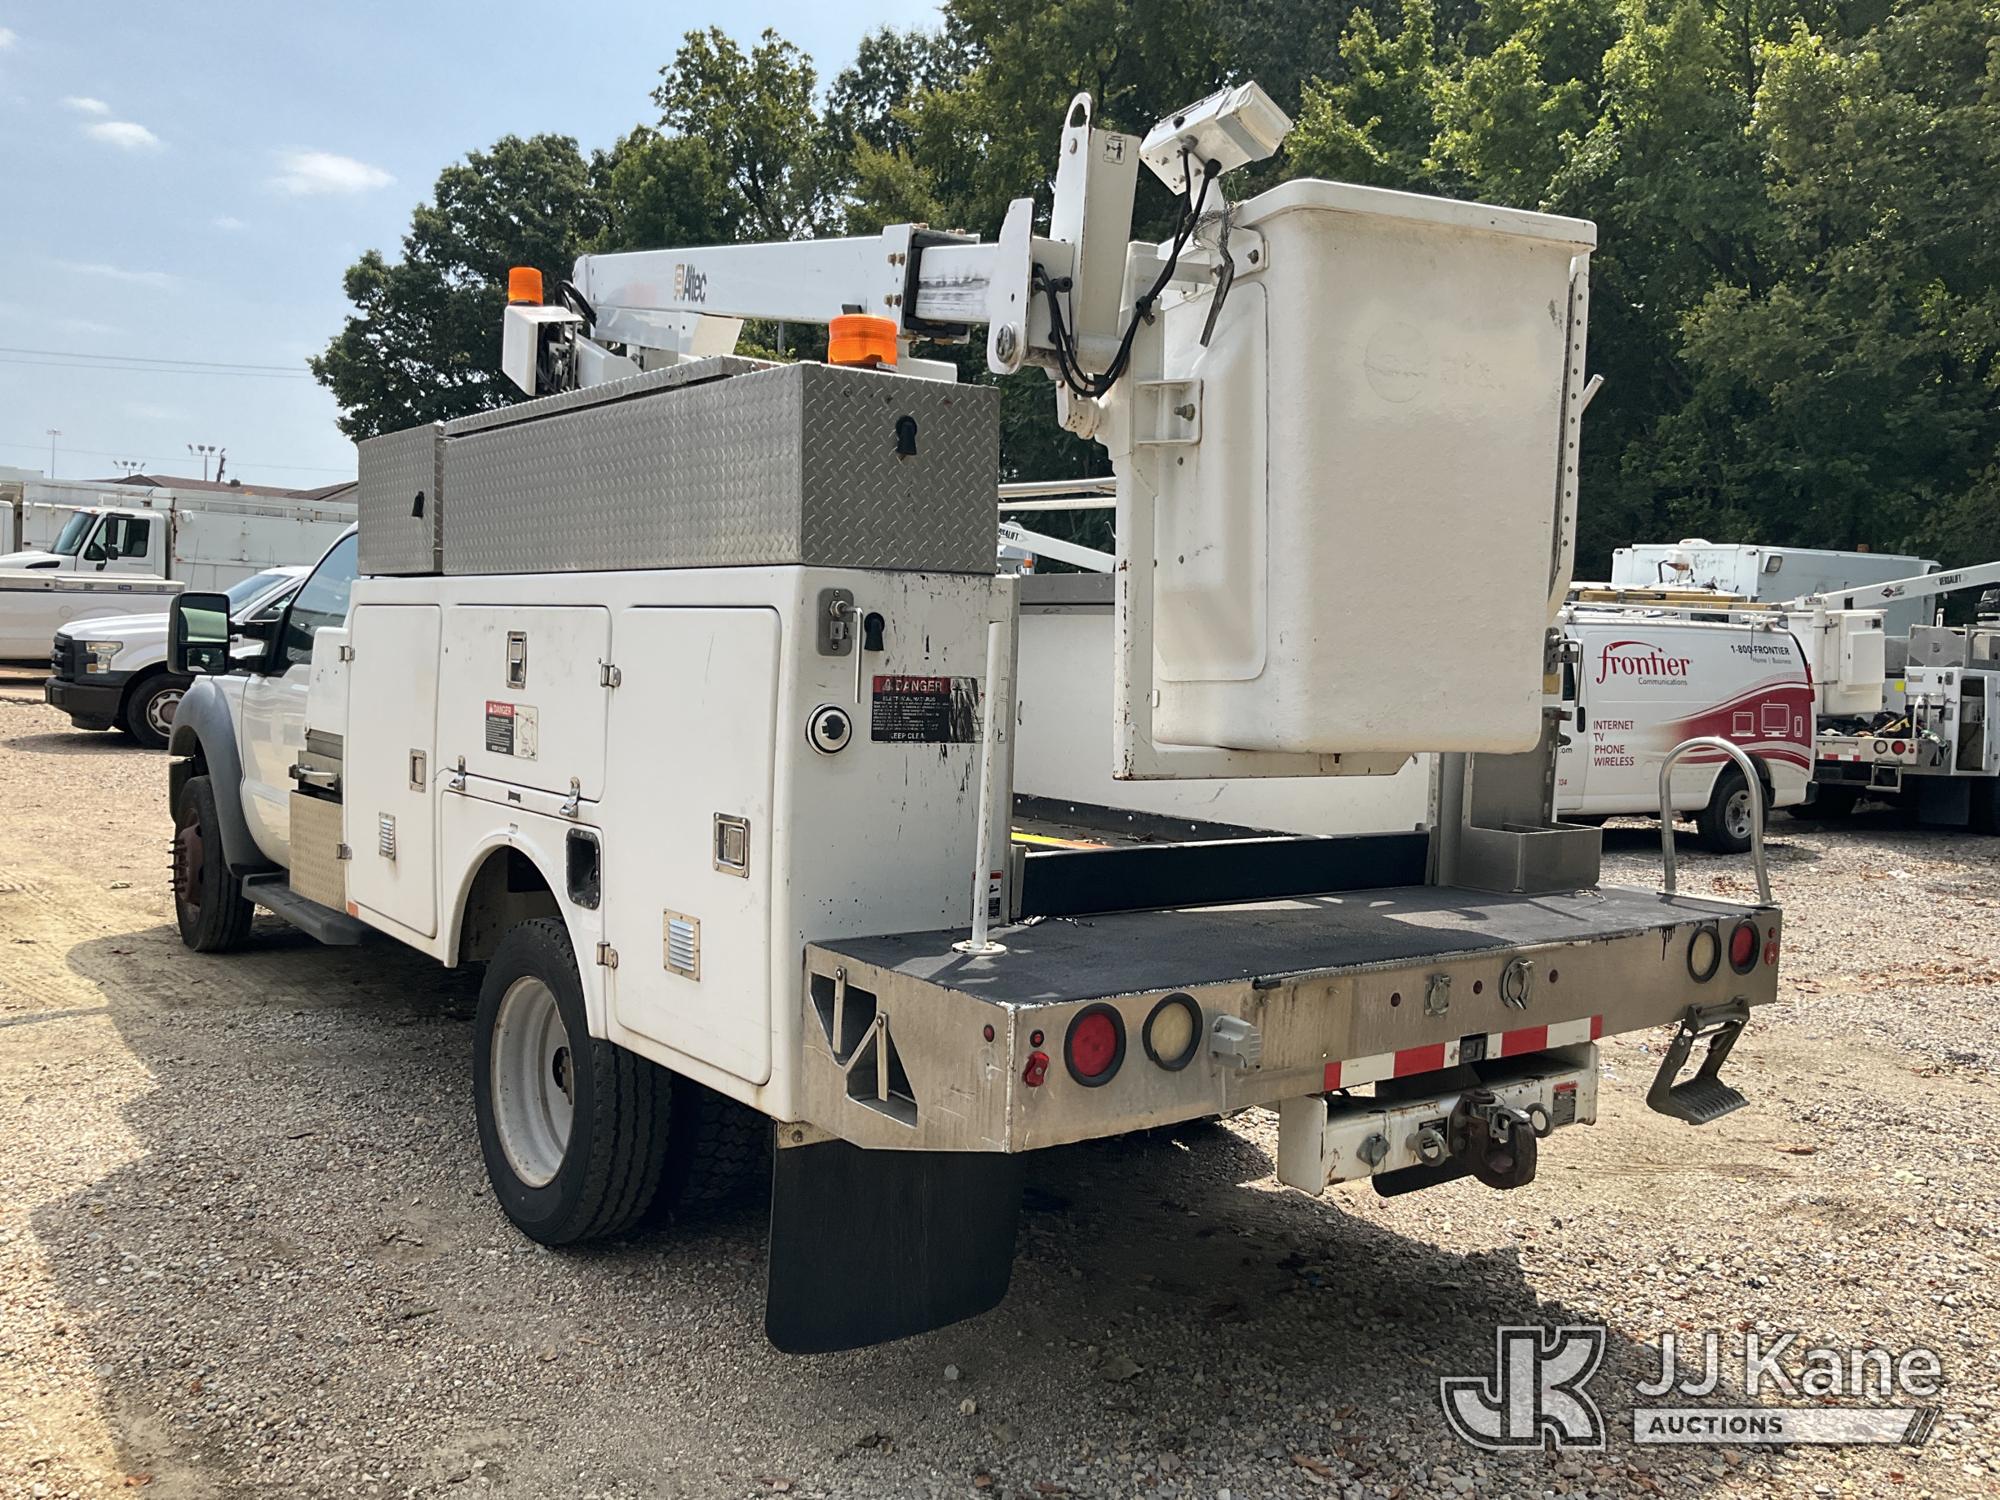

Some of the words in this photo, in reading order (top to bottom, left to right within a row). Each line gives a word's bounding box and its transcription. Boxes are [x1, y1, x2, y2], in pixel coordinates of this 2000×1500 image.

[682, 264, 708, 303] Altec
[1939, 574, 1962, 586] VERSALIFT
[1730, 644, 1790, 656] 1-800-FRONTIER
[1596, 640, 1690, 684] frontier
[896, 679, 942, 692] DANGER
[1638, 677, 1688, 686] Communications
[1593, 719, 1634, 730] INTERNET
[1594, 732, 1605, 742] TV
[1594, 744, 1625, 755] PHONE
[1593, 756, 1635, 767] WIRELESS
